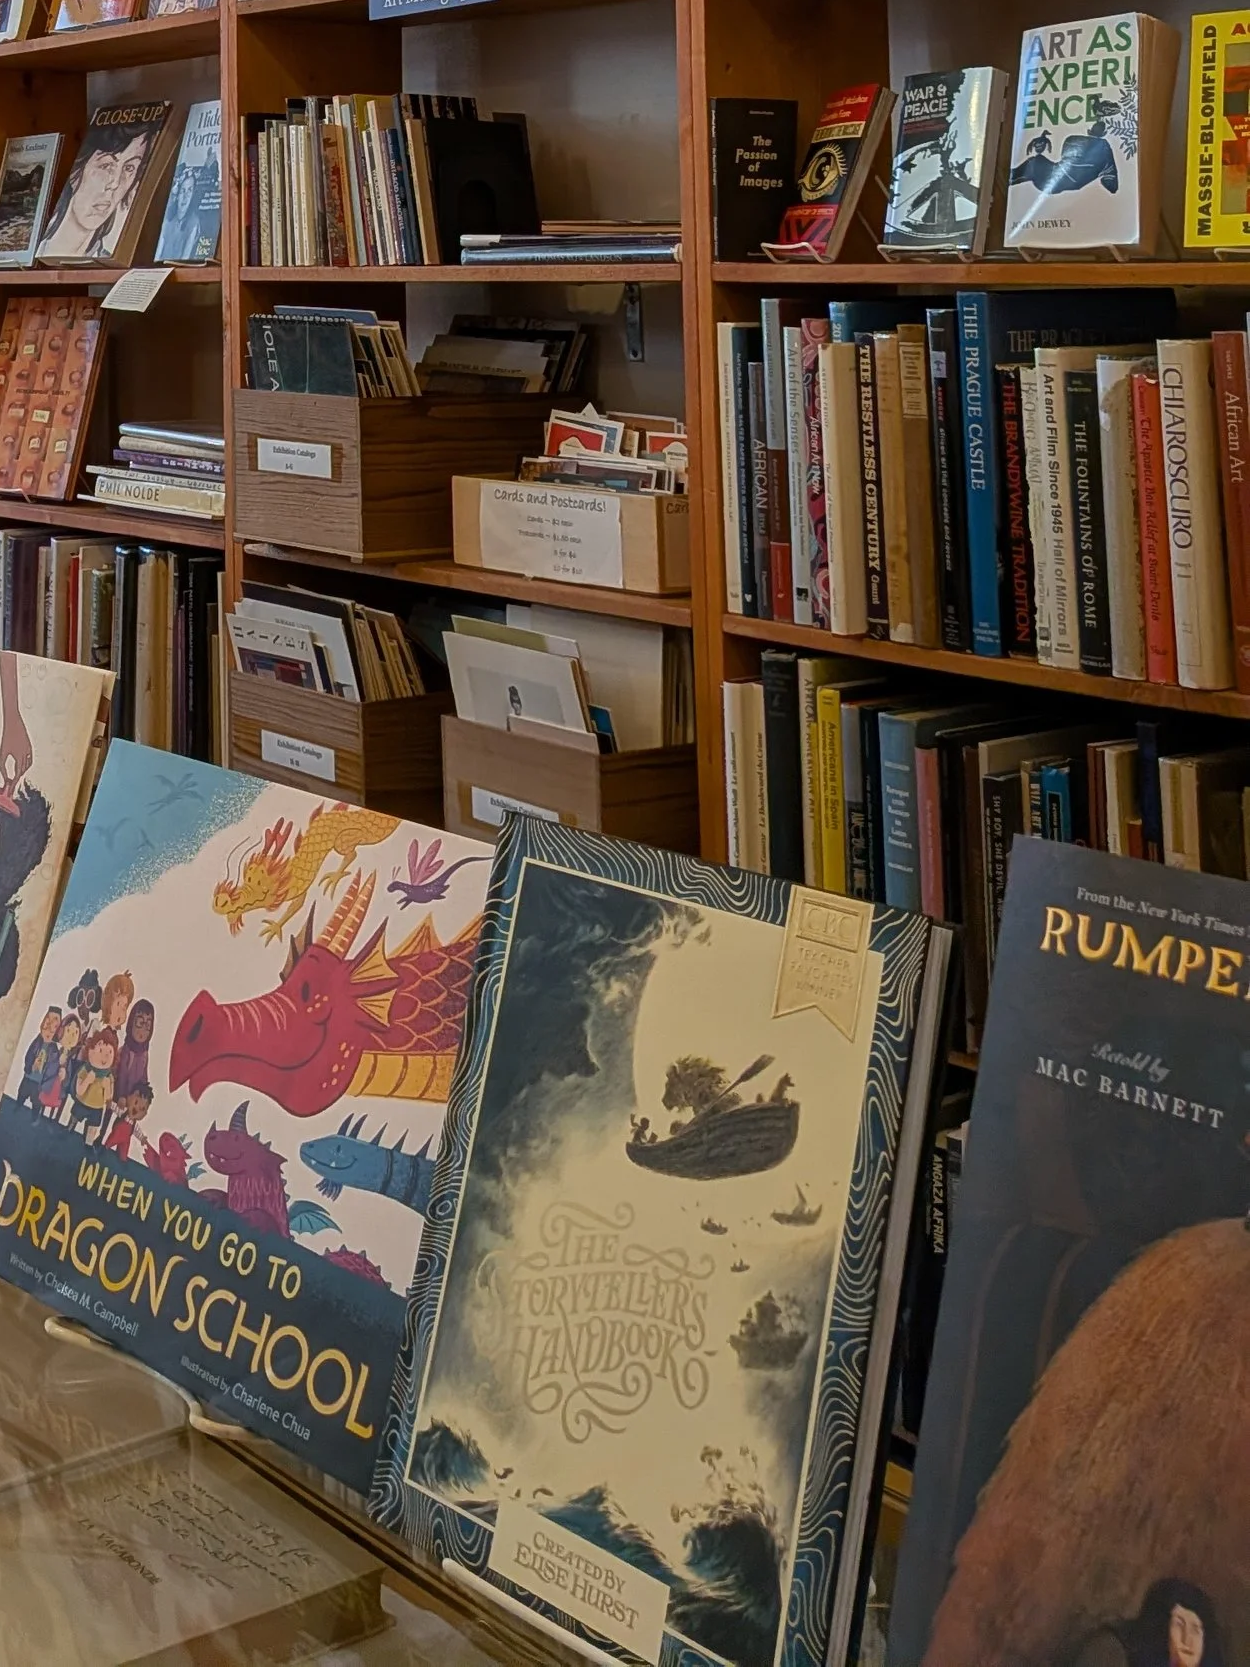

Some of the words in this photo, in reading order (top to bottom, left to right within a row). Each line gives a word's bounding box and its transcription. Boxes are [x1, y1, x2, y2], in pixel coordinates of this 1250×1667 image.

[1025, 28, 1083, 64] ART
[1086, 21, 1132, 55] AS
[905, 85, 935, 103] WAR
[1023, 55, 1132, 97] EXPERI
[96, 105, 163, 126] CLOSE-UP
[904, 98, 949, 118] PEACE
[753, 135, 772, 147] The
[1197, 24, 1217, 236] MASSIE-BLOMFIELD
[735, 149, 778, 164] Passion
[748, 162, 760, 173] of
[740, 176, 783, 190] Images
[1037, 219, 1072, 229] DEWEY
[963, 303, 979, 340] THE
[1007, 330, 1037, 353] THE
[858, 344, 871, 380] THE
[965, 346, 982, 419] PRAGUE
[1043, 373, 1054, 390] Art
[1003, 379, 1016, 416] THE
[1044, 394, 1055, 418] and
[790, 411, 800, 454] Senses
[809, 415, 819, 453] African
[860, 382, 877, 481] RESTLESS
[1046, 420, 1057, 456] Film
[1074, 421, 1086, 452] THE
[1225, 390, 1243, 451] African
[273, 445, 296, 456] Exhibition
[296, 448, 316, 458] Catalogs
[969, 424, 985, 491] CASTLE
[1162, 367, 1193, 550] CHIAROSCURO
[1230, 454, 1245, 484] Art
[99, 480, 123, 494] EMIL
[124, 484, 160, 502] NOLDE
[752, 438, 768, 510] AFRICAN
[811, 472, 822, 495] Now
[1003, 419, 1026, 538] BRANDYWINE
[1048, 457, 1059, 500] Since
[494, 488, 524, 503] Cards
[527, 493, 547, 506] and
[550, 494, 607, 513] Postcards!
[1051, 502, 1063, 534] 1945
[1076, 457, 1093, 552] FOUNTAINS
[865, 483, 881, 572] CENTURY
[1053, 540, 1065, 566] Hall
[1010, 544, 1031, 643] TRADITION
[1054, 585, 1067, 637] Mirrors
[1082, 581, 1097, 629] ROME
[277, 739, 301, 753] Exhibition
[301, 744, 323, 760] Catalogs
[828, 721, 837, 784] Americans
[830, 799, 840, 831] Spain
[1076, 886, 1111, 907] From
[1113, 895, 1136, 912] the
[1137, 901, 1168, 919] New
[1171, 907, 1202, 927] York
[1204, 916, 1245, 936] Times
[1040, 905, 1250, 1001] RUMPE
[1091, 1041, 1150, 1072] Retold
[1148, 1056, 1171, 1083] by
[1036, 1056, 1089, 1088] MAC
[1098, 1074, 1224, 1129] BARNETT
[931, 1154, 945, 1207] ANGAZA
[77, 1158, 154, 1221] WHEN
[162, 1199, 212, 1252] YOU
[219, 1232, 257, 1276] GO
[268, 1255, 302, 1300] TO
[932, 1208, 945, 1254] AFRIKA
[9, 1252, 36, 1277] Written
[44, 1272, 79, 1302] Chelsea
[79, 1291, 92, 1312] M.
[93, 1300, 140, 1337] Campbell
[173, 1275, 374, 1440] SCHOOL
[180, 1355, 220, 1388] Illustrated
[219, 1377, 231, 1394] by
[232, 1382, 281, 1423] Charlene
[281, 1411, 311, 1442] Chua
[92, 1527, 161, 1588] VAGABONDE
[532, 1531, 603, 1581] CREATED
[603, 1568, 627, 1595] BY
[513, 1542, 569, 1591] ELISE
[568, 1570, 639, 1632] HURST
